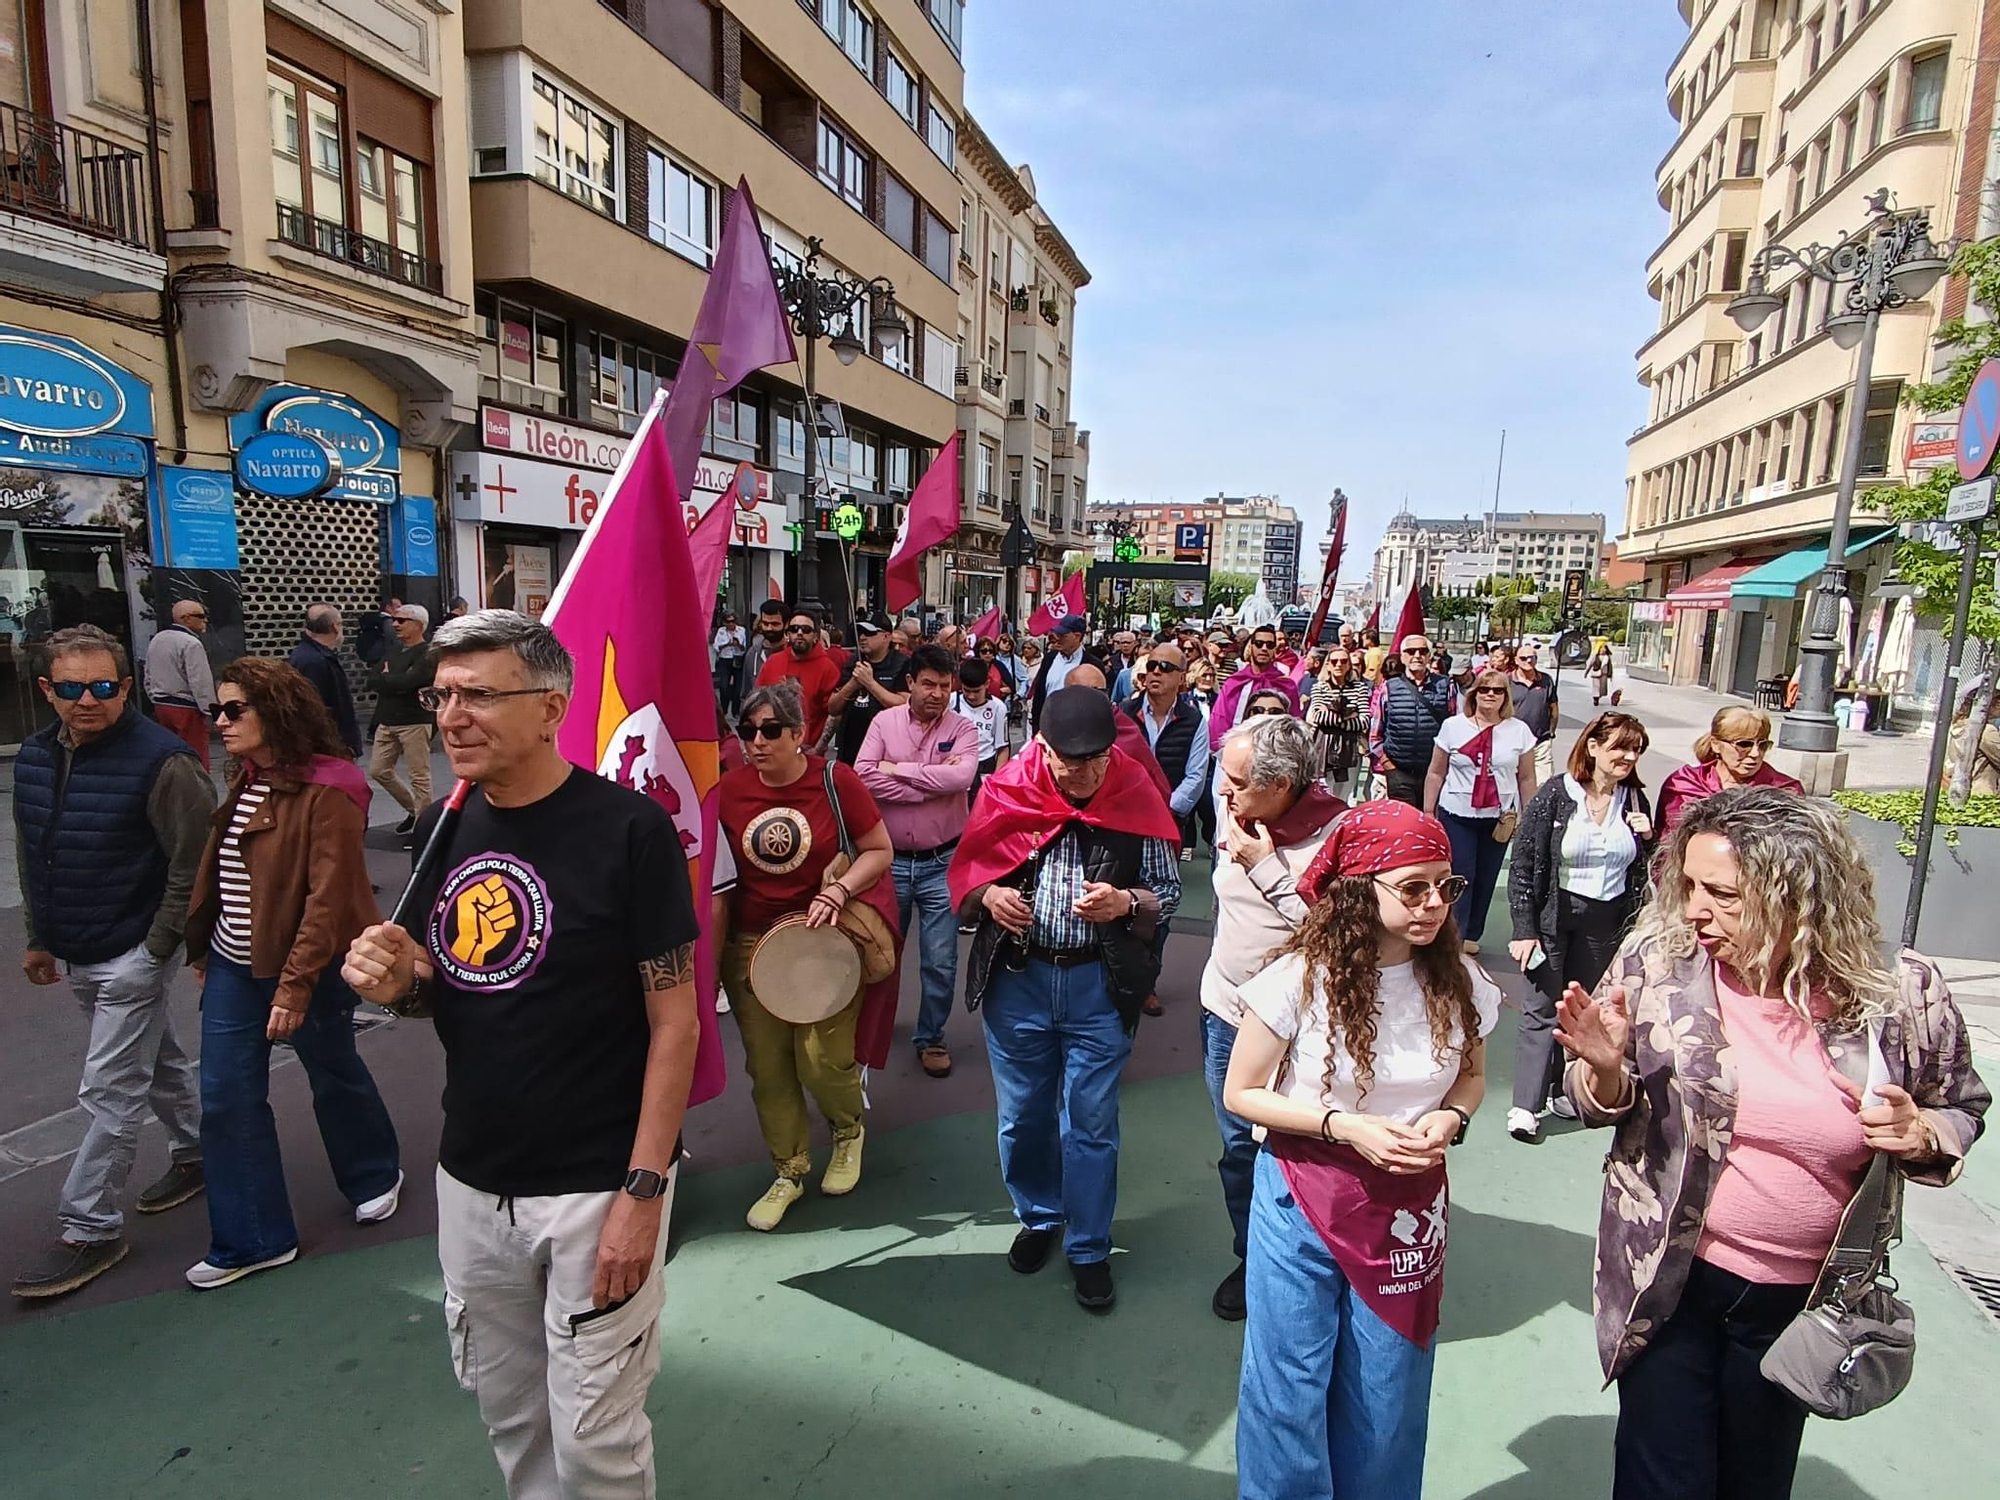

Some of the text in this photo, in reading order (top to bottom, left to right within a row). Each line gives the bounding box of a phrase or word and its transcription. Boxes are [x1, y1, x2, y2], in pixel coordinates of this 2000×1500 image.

[486, 421, 510, 437] ileón
[272, 448, 316, 459] OPTICA
[525, 418, 627, 469] ileón.co
[246, 460, 321, 479] Navarro
[836, 514, 861, 528] 24h
[1182, 526, 1197, 547] P
[445, 877, 460, 897] NUN
[486, 860, 508, 872] POLA
[508, 864, 530, 886] TIERRA
[527, 883, 541, 901] QUE
[438, 952, 456, 975] POLA
[456, 968, 487, 983] TIERRA
[489, 970, 510, 984] QUE
[510, 952, 533, 974] CHORA
[1395, 1250, 1427, 1273] UPL
[1379, 1282, 1406, 1294] UNIÓN
[1407, 1280, 1423, 1292] DEL
